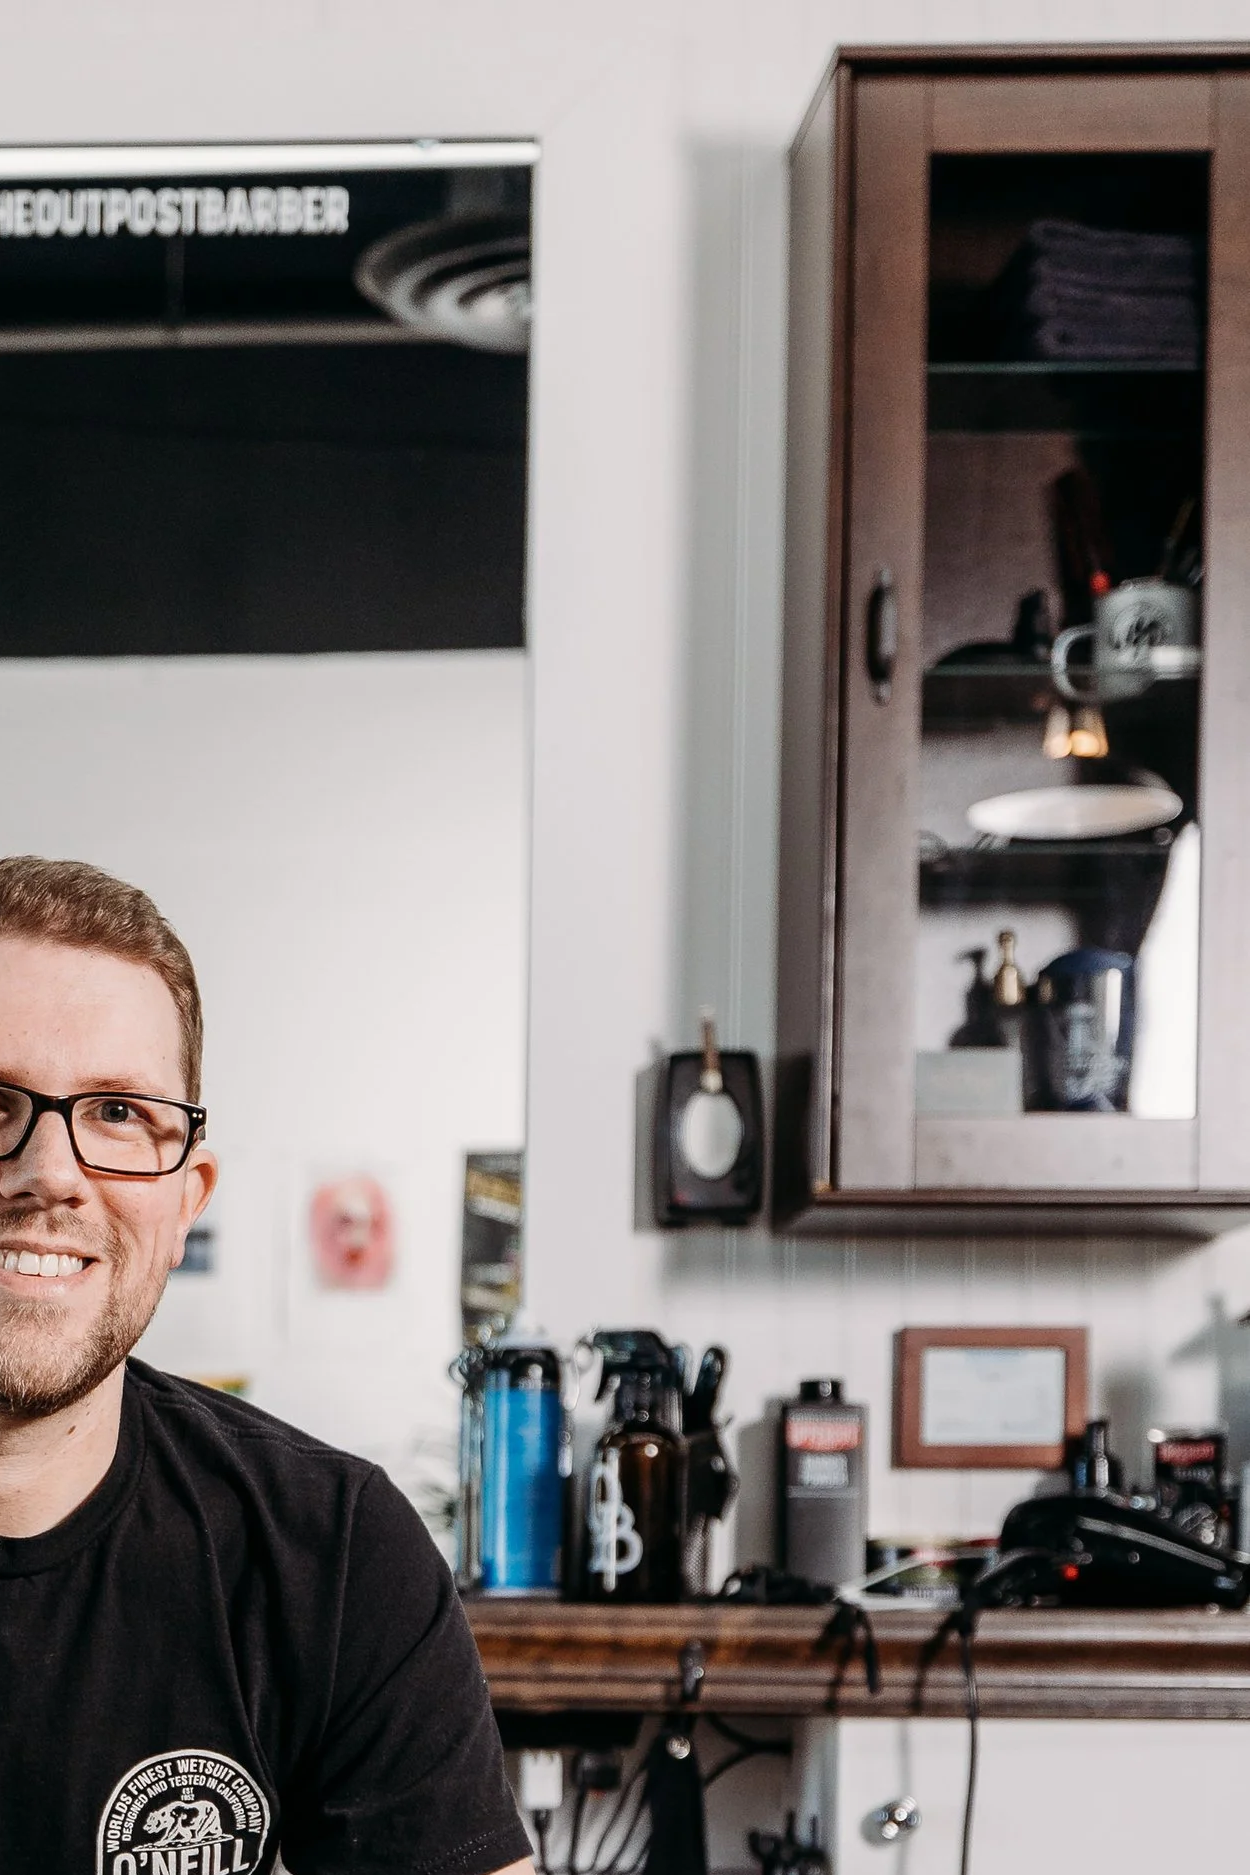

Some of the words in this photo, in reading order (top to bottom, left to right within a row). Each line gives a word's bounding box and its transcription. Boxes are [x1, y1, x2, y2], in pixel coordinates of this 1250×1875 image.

[107, 1793, 133, 1853] WORLDS
[127, 1762, 173, 1796] FINEST
[176, 1758, 236, 1782] WETSUIT
[231, 1778, 262, 1834] COMPANY
[121, 1793, 149, 1842] DESIGNED
[146, 1780, 169, 1798] AND
[168, 1774, 207, 1788] TESTED
[206, 1777, 218, 1790] IN
[216, 1783, 247, 1831] CALIFORNIA
